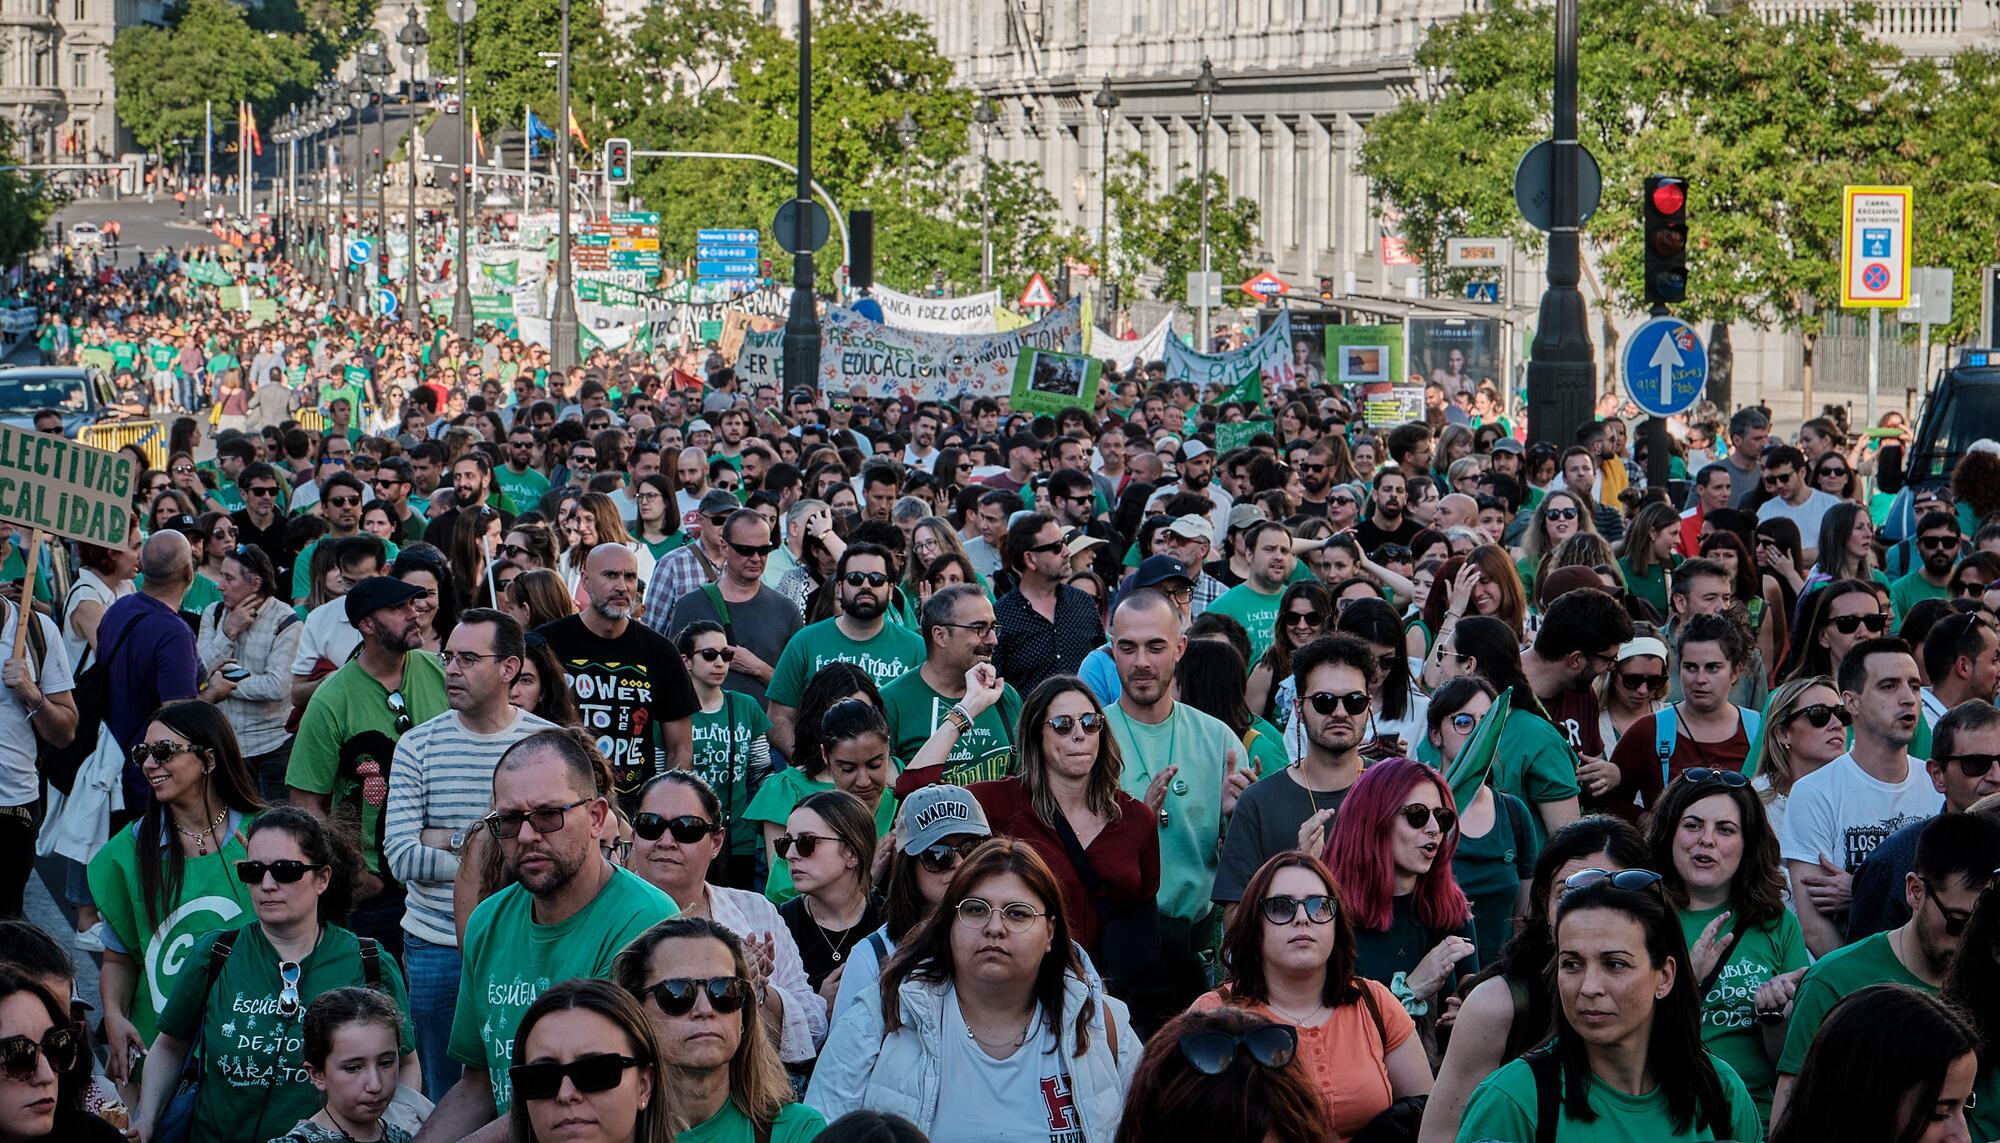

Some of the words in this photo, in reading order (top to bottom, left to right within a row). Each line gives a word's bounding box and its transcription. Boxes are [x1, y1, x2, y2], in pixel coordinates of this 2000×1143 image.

[951, 302, 992, 321] OCHOA
[0, 428, 131, 498] LECTIVAS
[579, 703, 612, 729] TO
[595, 734, 644, 766] OPLE
[915, 801, 968, 831] MADRID
[1849, 834, 1877, 852] LOS
[1705, 986, 1758, 1003] OD@S
[237, 1034, 265, 1051] DE
[495, 1038, 515, 1060] DE
[222, 1063, 274, 1079] PARA
